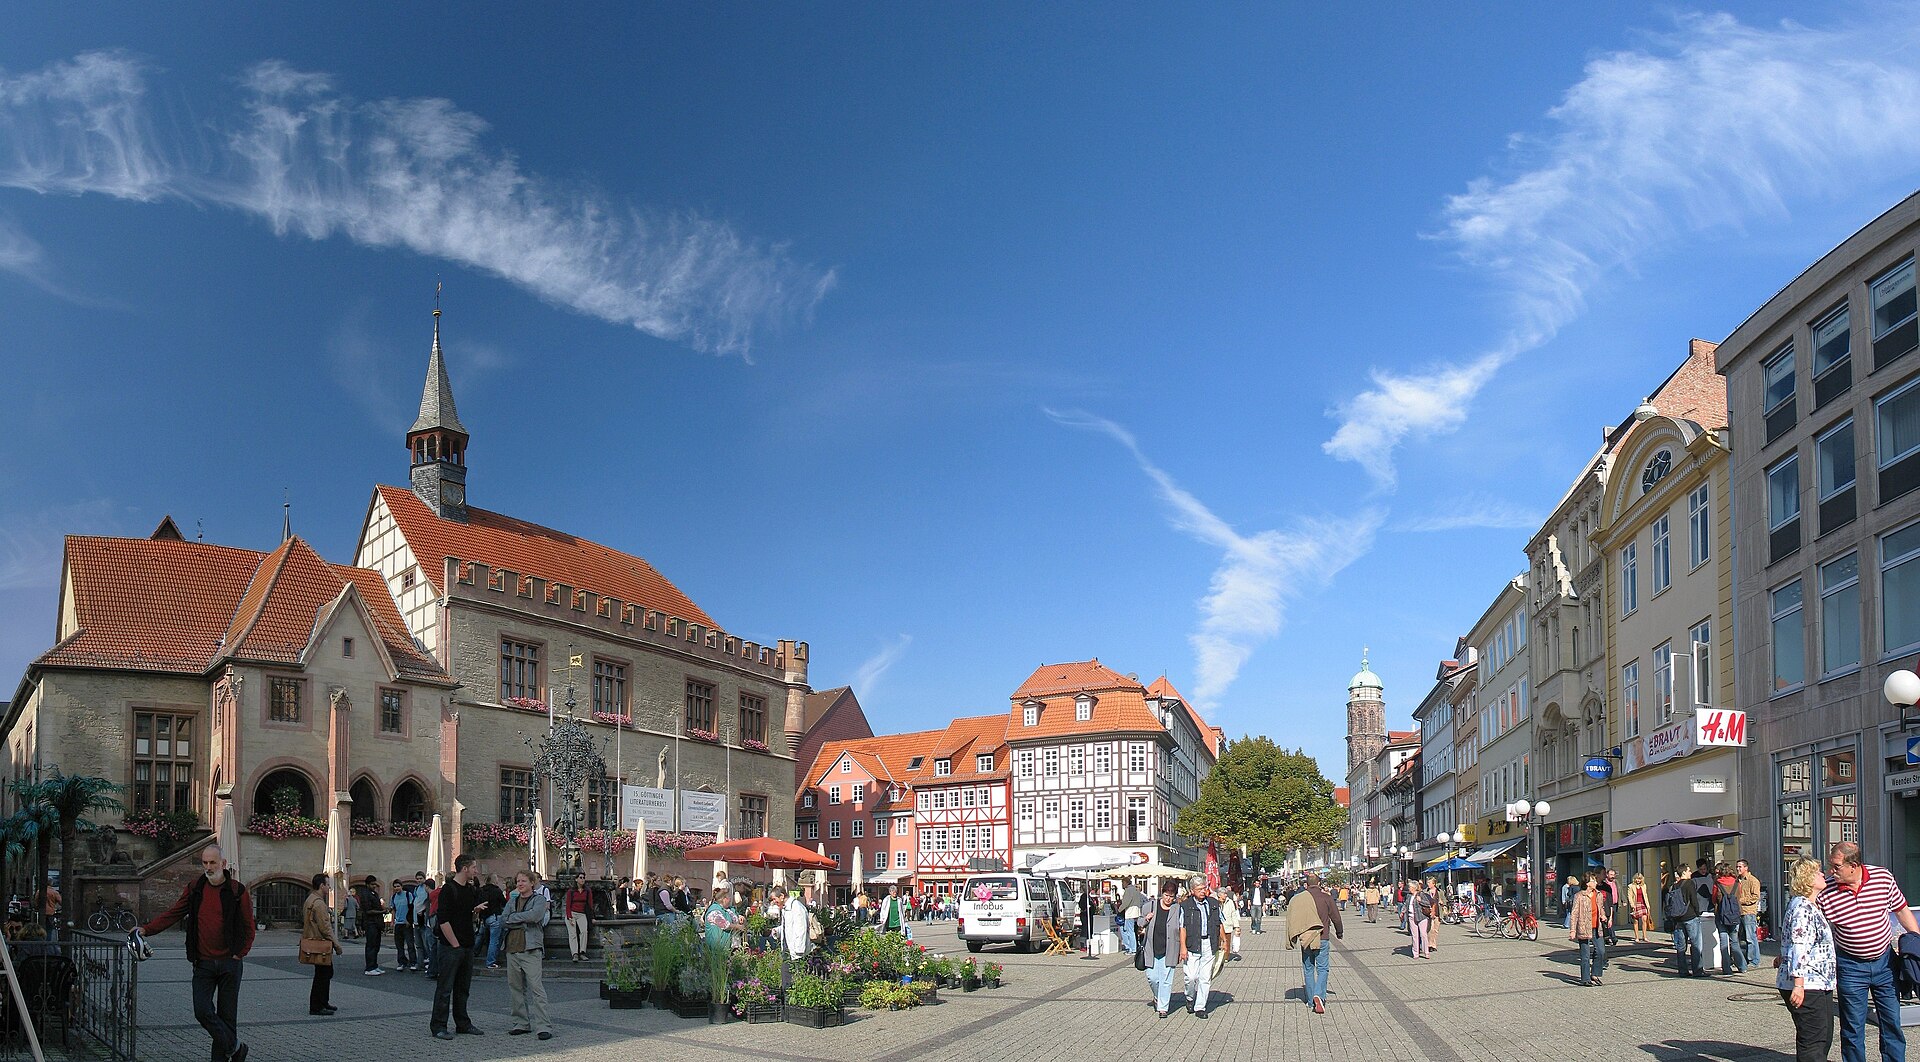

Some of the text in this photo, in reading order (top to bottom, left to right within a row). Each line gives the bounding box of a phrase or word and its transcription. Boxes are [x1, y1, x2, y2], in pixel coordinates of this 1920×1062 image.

[1701, 711, 1745, 745] H&M
[1653, 725, 1681, 748] BRAUT
[1891, 776, 1912, 786] Weender
[641, 791, 664, 799] GÖTTINGER
[630, 799, 667, 808] LITERATURHERBST
[973, 901, 1004, 910] InfoBus
